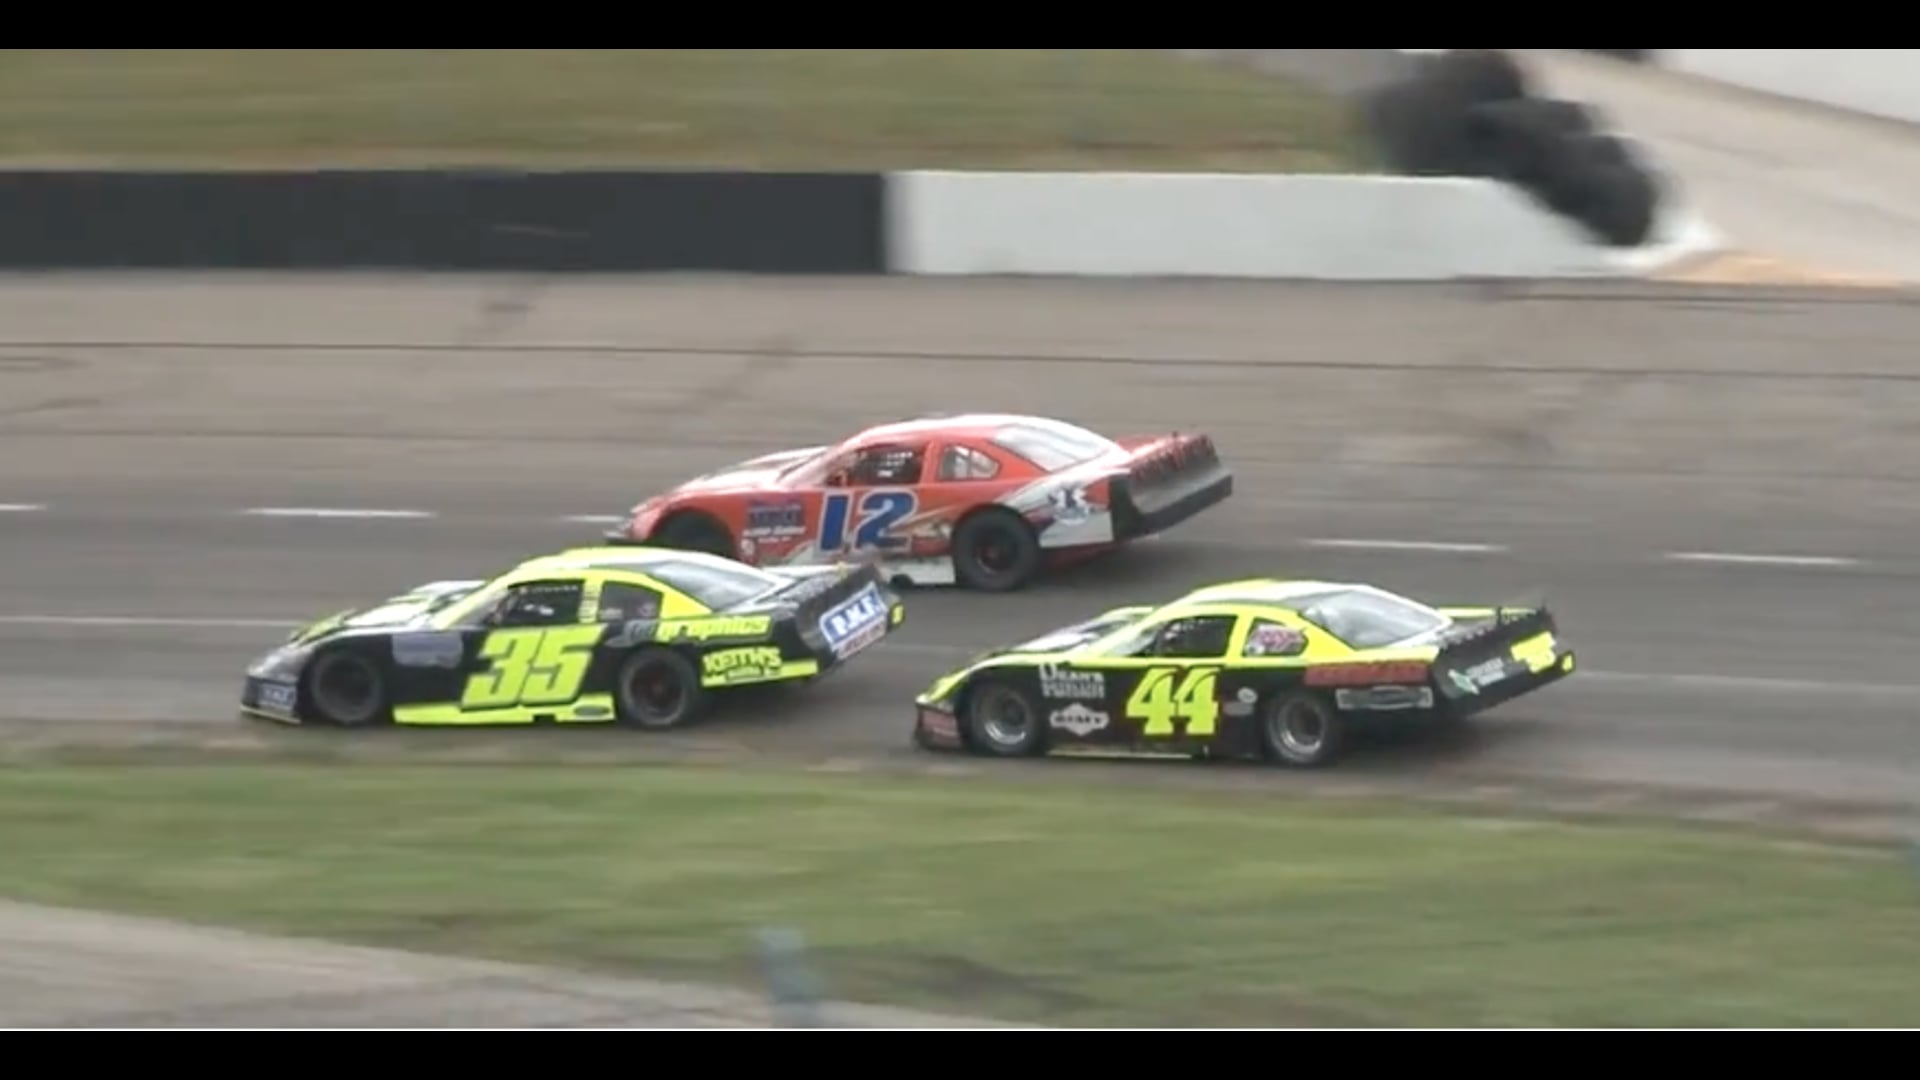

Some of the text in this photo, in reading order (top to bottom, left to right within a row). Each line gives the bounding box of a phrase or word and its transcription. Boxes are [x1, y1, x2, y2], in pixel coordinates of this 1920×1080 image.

[819, 487, 918, 552] 12
[461, 624, 607, 709] 35
[1126, 667, 1219, 735] 44
